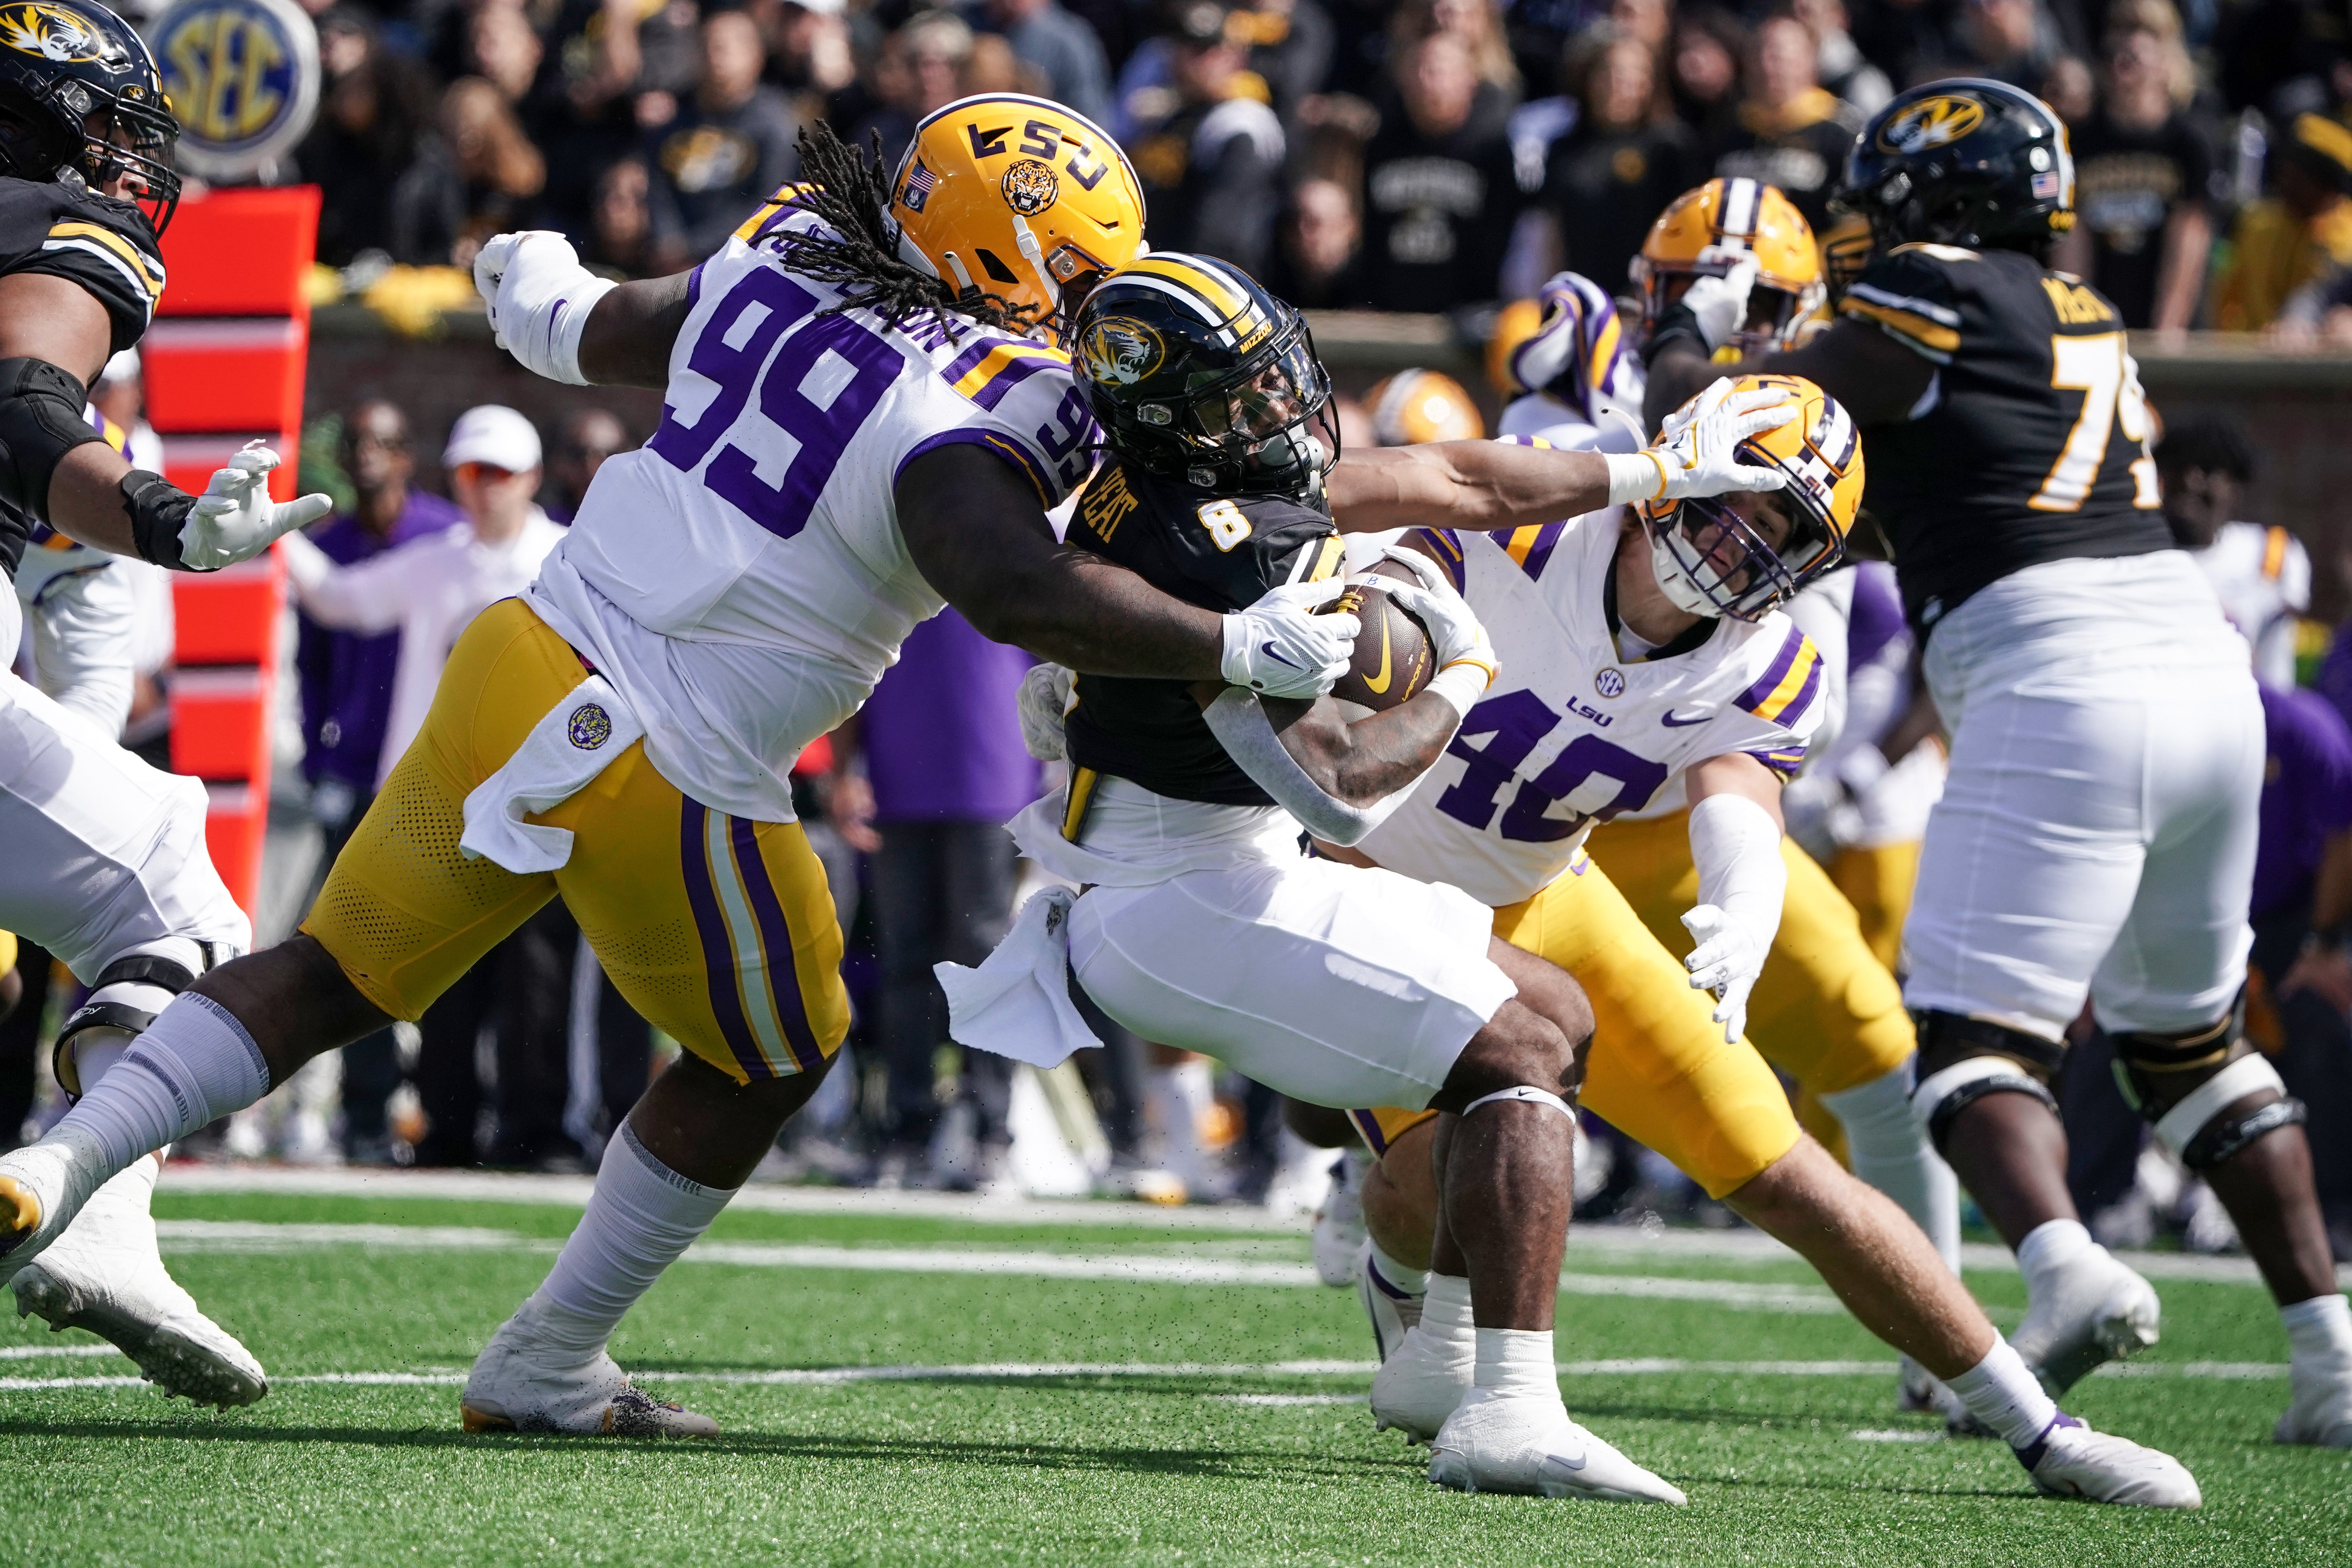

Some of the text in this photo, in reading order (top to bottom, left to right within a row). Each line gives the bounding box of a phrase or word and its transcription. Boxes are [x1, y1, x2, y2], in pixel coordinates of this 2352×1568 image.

[166, 9, 284, 141] SEC
[967, 119, 1108, 191] LSU
[1239, 322, 1273, 354] MIZZOU
[646, 265, 905, 540] 99
[1083, 467, 1139, 544] PEAT
[1197, 499, 1252, 553] 8
[1401, 663, 1423, 702] VAPOR
[1419, 635, 1428, 663] ELIT
[1597, 669, 1623, 696] SEC
[1566, 695, 1614, 727] LSU
[1436, 688, 1668, 842] 40
